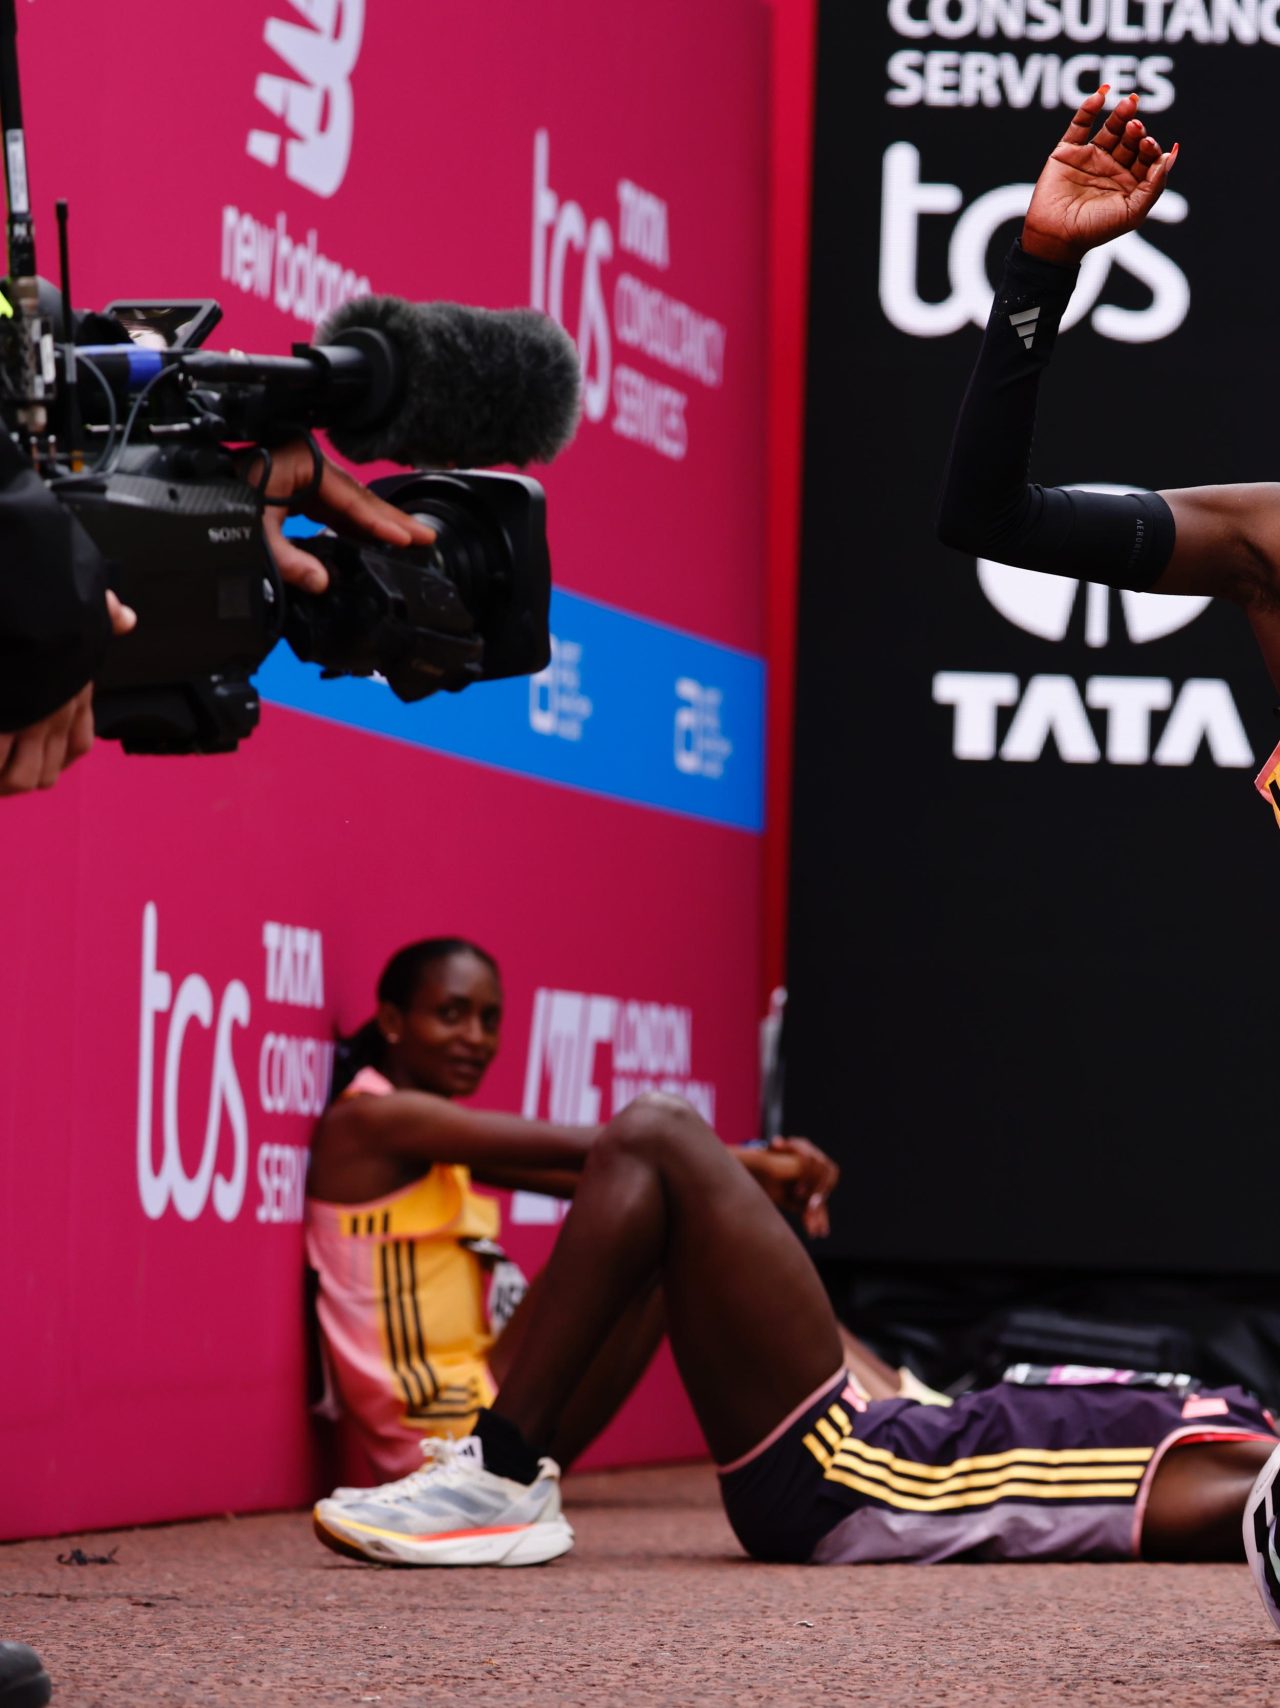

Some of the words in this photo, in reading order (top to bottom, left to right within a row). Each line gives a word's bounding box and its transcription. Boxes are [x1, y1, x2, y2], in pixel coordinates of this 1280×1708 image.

[886, 50, 1176, 113] SERVICES
[221, 204, 276, 300] new
[879, 140, 1191, 343] tcs
[208, 526, 252, 542] SONY
[931, 670, 1256, 769] TATA
[262, 920, 325, 1009] TATA
[137, 899, 251, 1222] tcs
